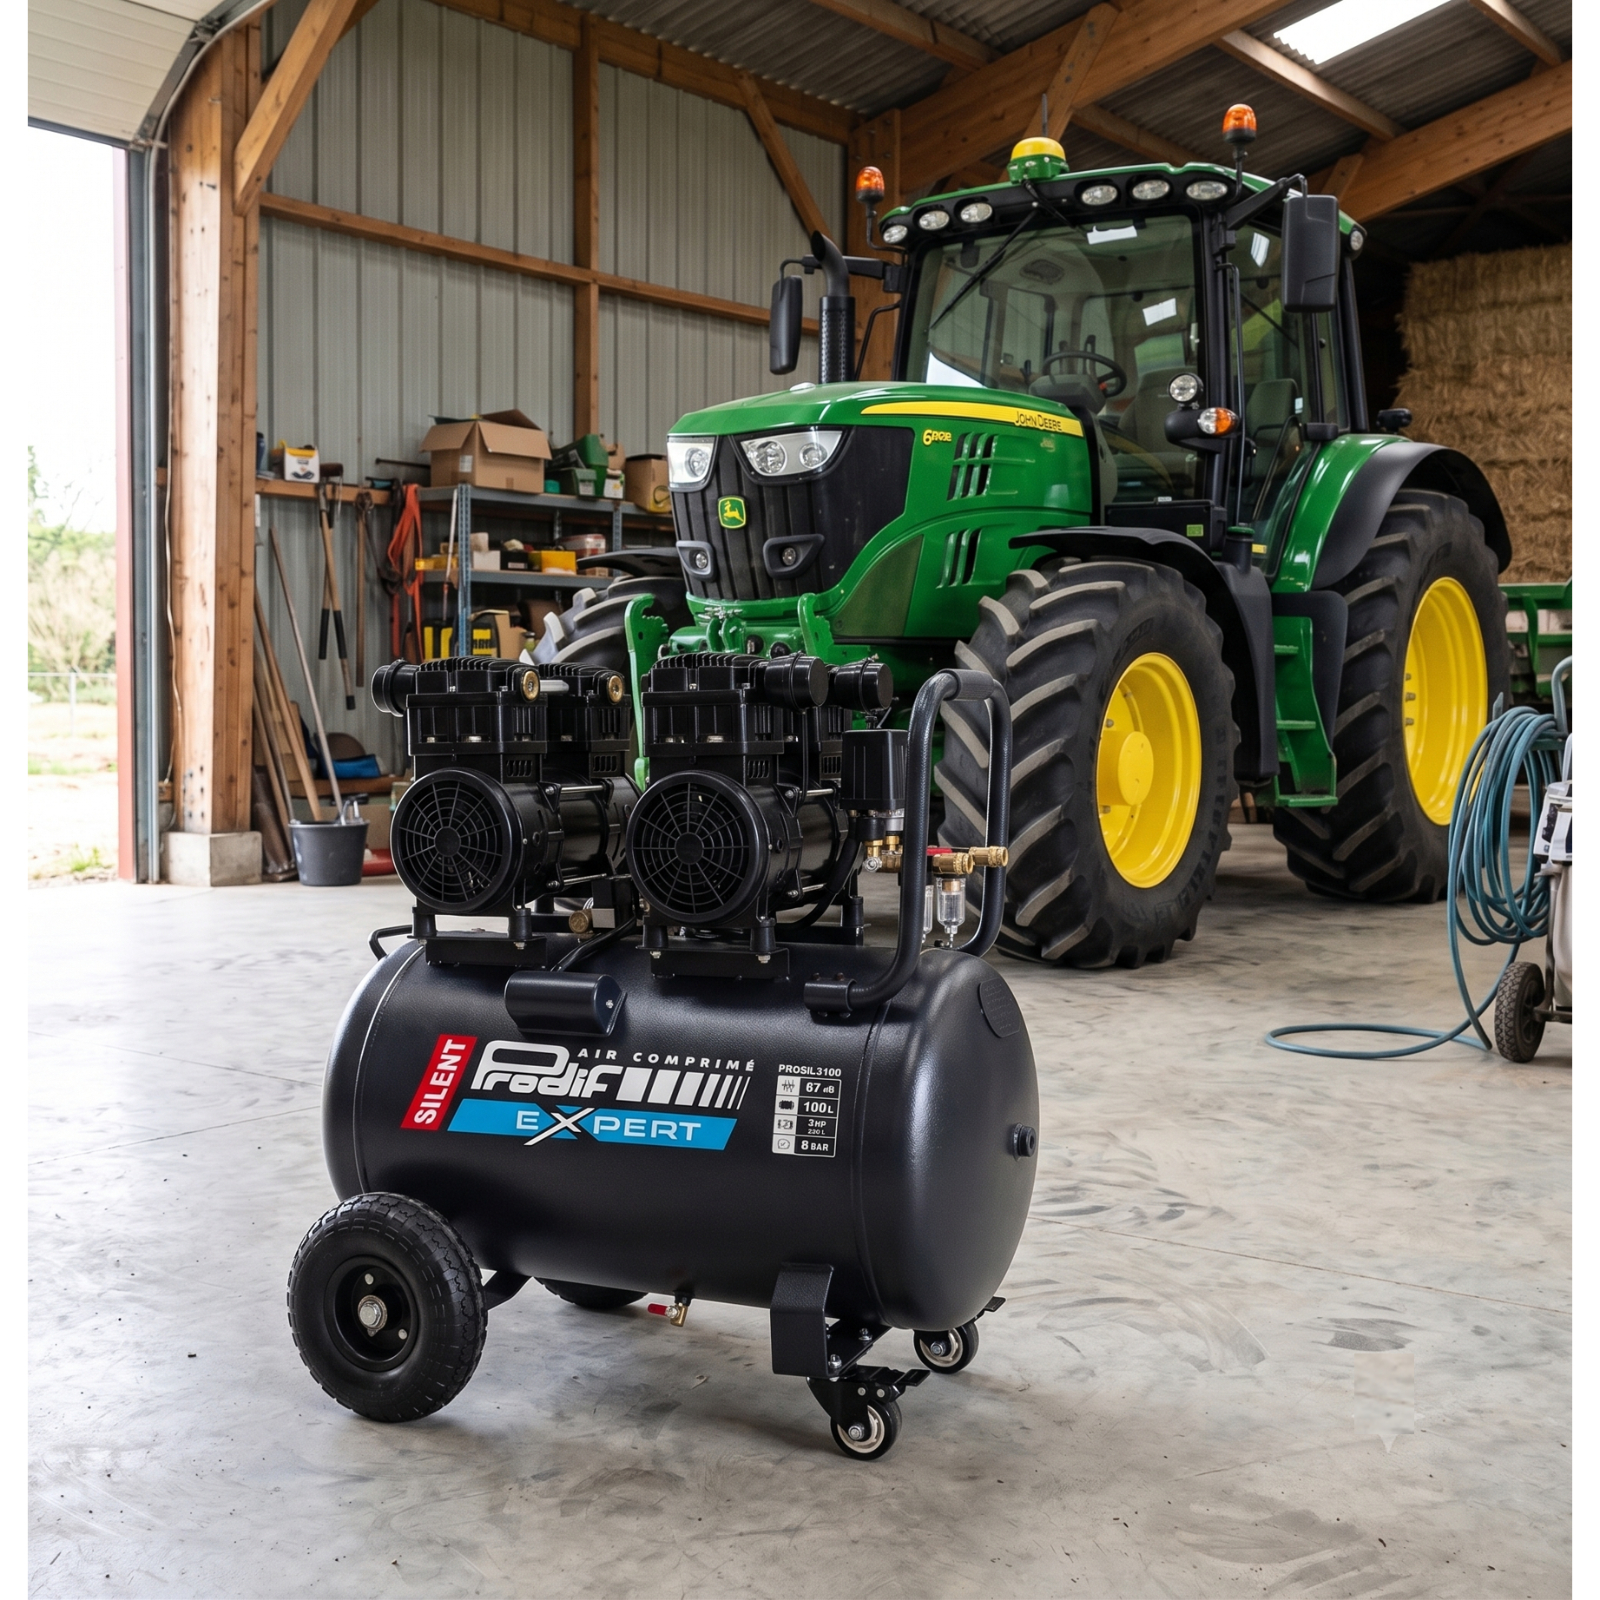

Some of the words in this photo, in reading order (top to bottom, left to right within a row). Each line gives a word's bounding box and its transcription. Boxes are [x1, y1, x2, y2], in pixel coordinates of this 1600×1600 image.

[1015, 411, 1037, 426] JOHN
[1037, 414, 1062, 431] DEERE
[470, 1040, 624, 1099] Prodif
[577, 1047, 618, 1060] AIR
[633, 1051, 755, 1072] COMPRIMÉ
[778, 1064, 842, 1077] PROSIL3100
[413, 1038, 467, 1126] SILENT
[806, 1082, 821, 1093] 67
[515, 1107, 702, 1146] EXPERT
[801, 1139, 809, 1151] 8
[810, 1142, 829, 1152] BAR
